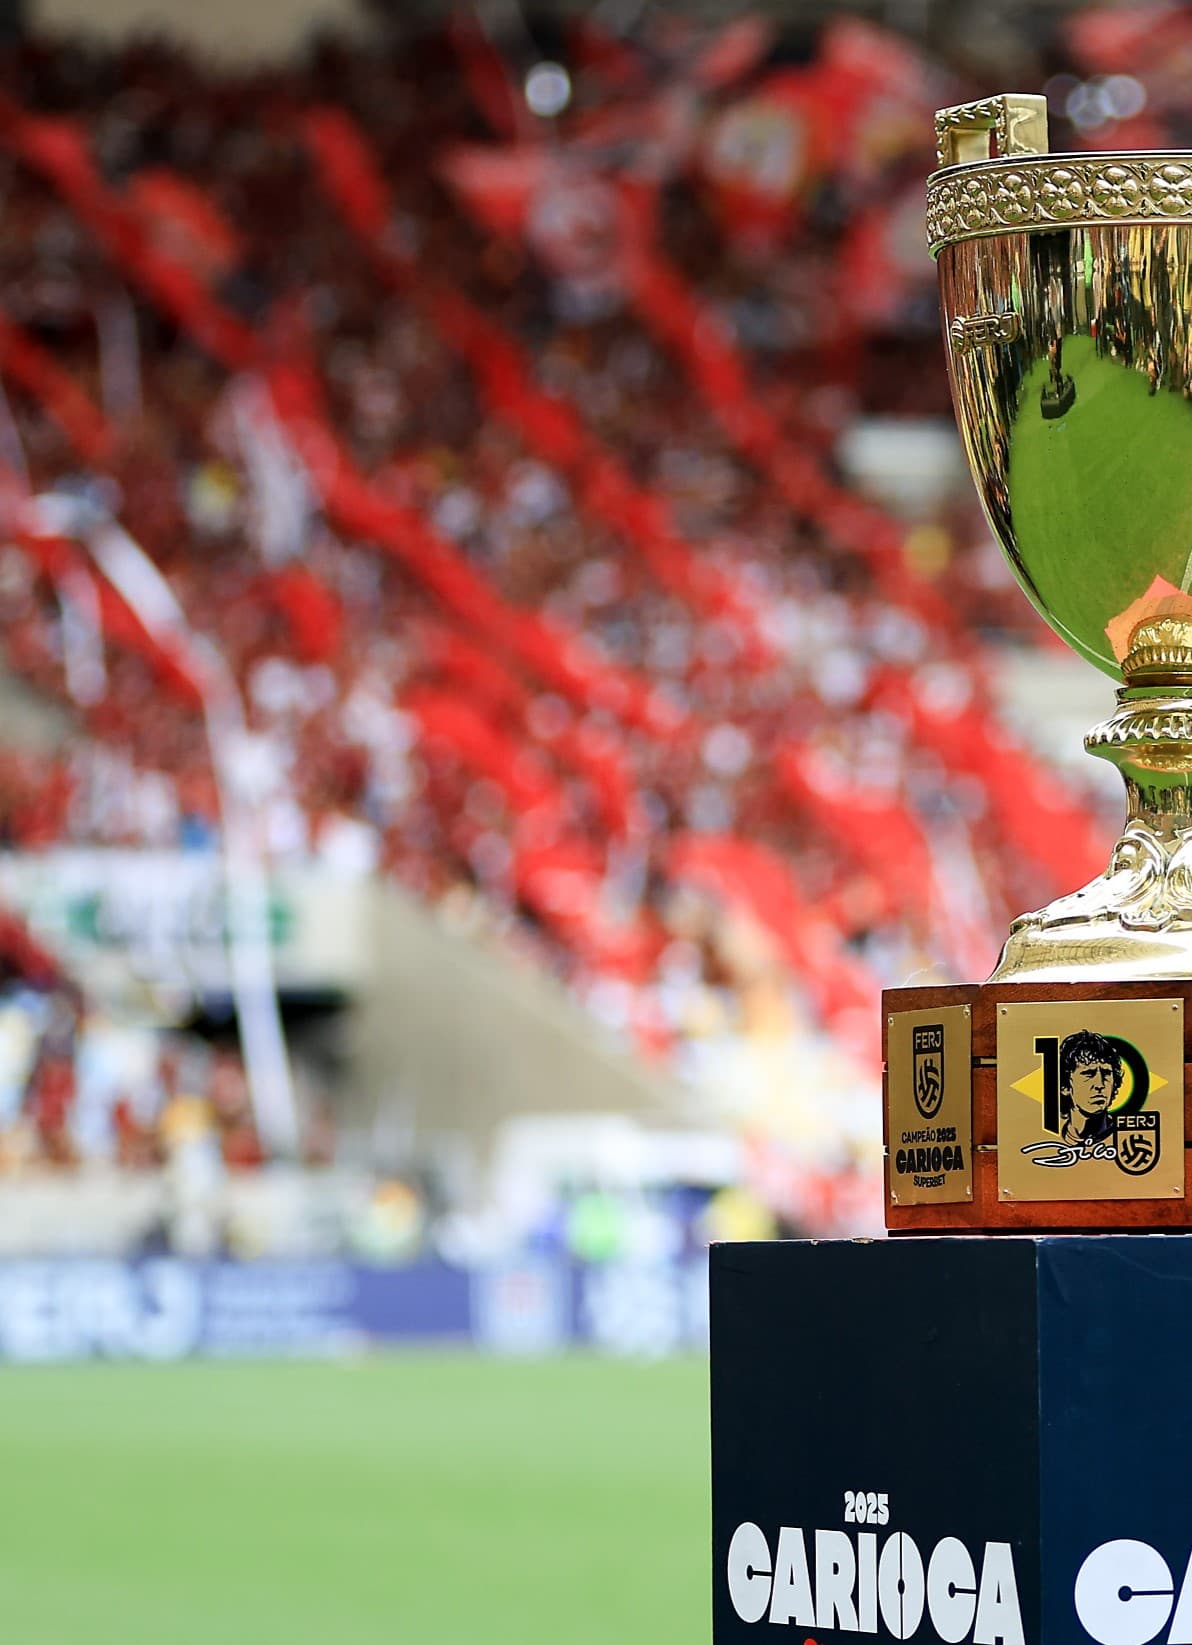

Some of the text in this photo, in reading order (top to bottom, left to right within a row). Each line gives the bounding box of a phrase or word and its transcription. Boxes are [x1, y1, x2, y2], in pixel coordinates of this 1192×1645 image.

[915, 1031, 942, 1049] FERJ
[1116, 1115, 1156, 1128] FERJ
[901, 1127, 956, 1144] CAMPEÃO 2025
[895, 1145, 965, 1174] CARIOCA
[913, 1173, 946, 1188] SUPERBET
[844, 1491, 889, 1525] 2025
[727, 1521, 1026, 1645] CARIOCA
